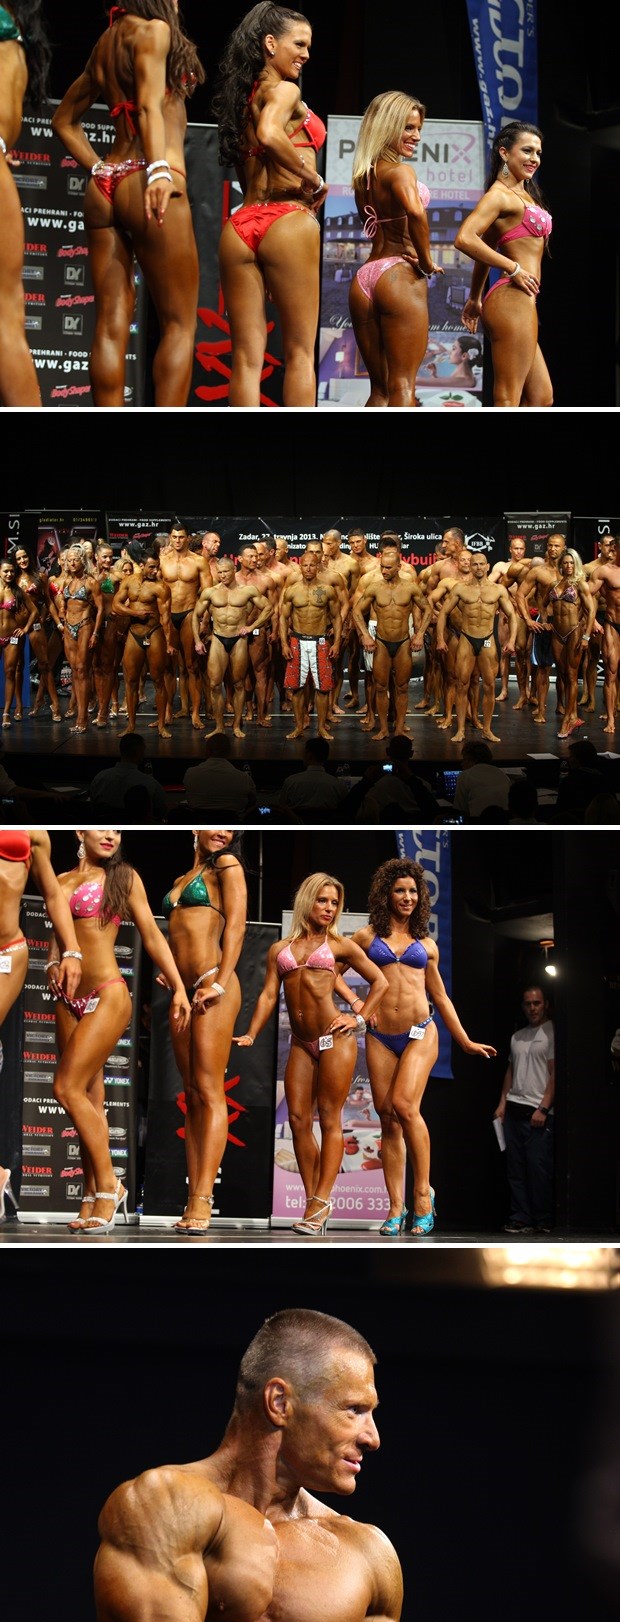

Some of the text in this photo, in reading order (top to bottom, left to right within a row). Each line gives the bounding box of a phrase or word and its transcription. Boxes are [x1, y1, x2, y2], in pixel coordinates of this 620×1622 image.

[426, 168, 473, 183] hotel
[442, 190, 470, 200] HOTEL
[33, 208, 68, 216] PREHRANI
[29, 348, 63, 357] PREHRANI
[239, 533, 260, 541] Zadar,
[404, 531, 442, 540] Široka ulica
[23, 1052, 57, 1060] WEIDER
